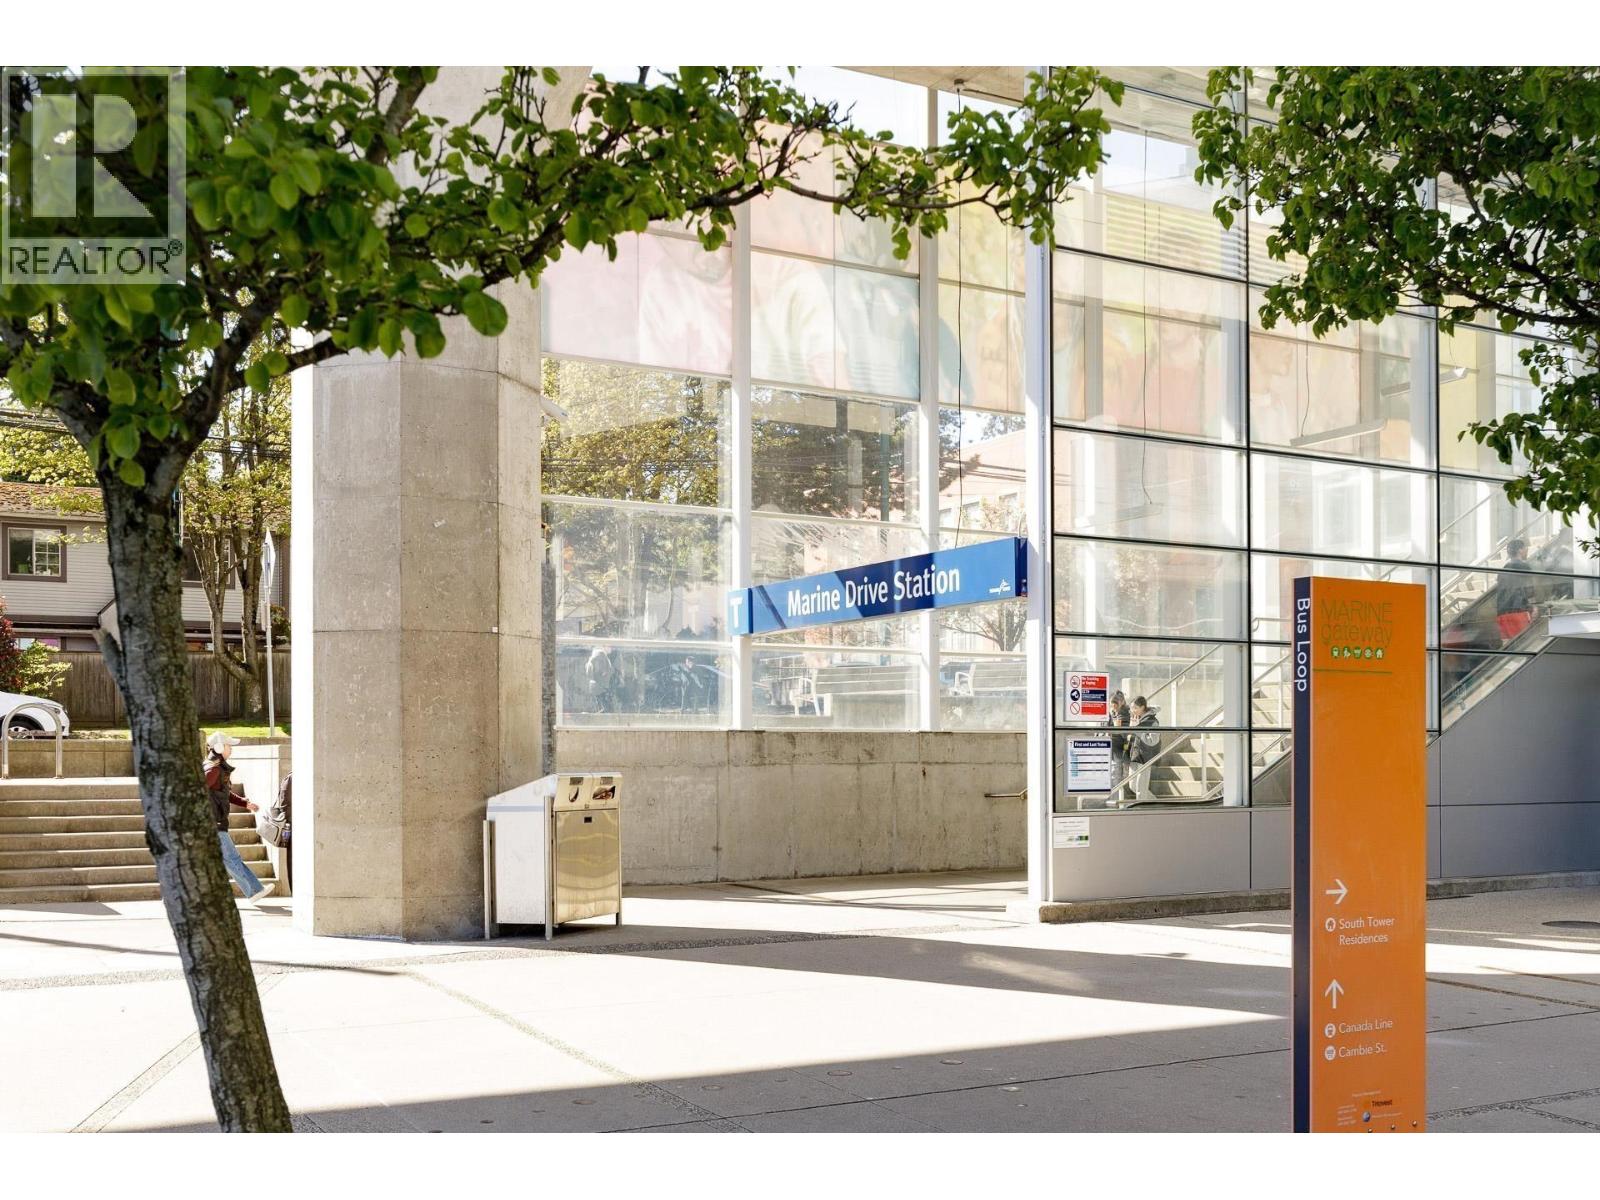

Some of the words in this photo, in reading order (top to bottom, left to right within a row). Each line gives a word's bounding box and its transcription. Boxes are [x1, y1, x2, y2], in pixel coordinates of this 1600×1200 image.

[787, 583, 841, 618] Marine
[845, 576, 888, 609] Drive
[893, 564, 960, 601] Station
[1296, 597, 1311, 634] Bus
[1320, 598, 1393, 625] MARINE
[1320, 621, 1393, 648] gateway
[1294, 640, 1311, 692] Loop
[1338, 917, 1365, 930] South
[1367, 916, 1395, 928] Tower
[1338, 933, 1389, 946] Residences
[1338, 1020, 1373, 1035] Canada
[1375, 1018, 1393, 1030] Line
[1338, 1044, 1373, 1058] Cambie
[1375, 1042, 1388, 1053] St.
